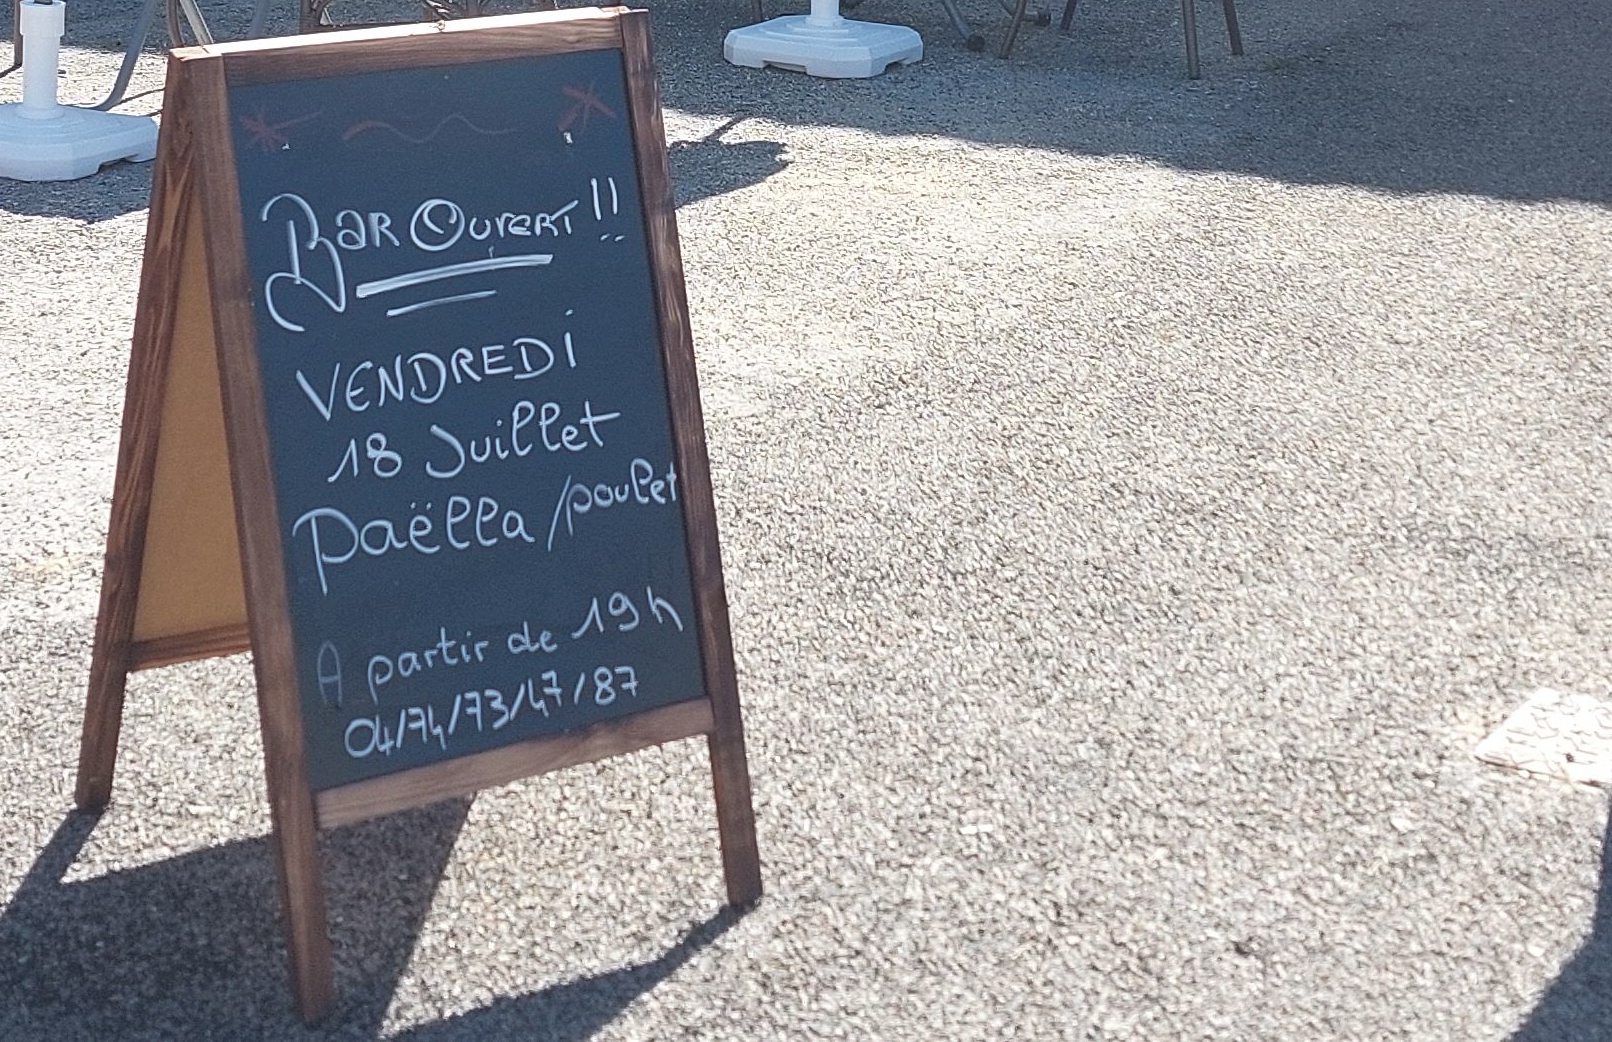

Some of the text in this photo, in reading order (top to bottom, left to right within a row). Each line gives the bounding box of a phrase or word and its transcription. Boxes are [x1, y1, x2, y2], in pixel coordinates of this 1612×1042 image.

[327, 399, 622, 484] 18 Juillet
[366, 625, 490, 705] partir
[507, 621, 559, 655] de
